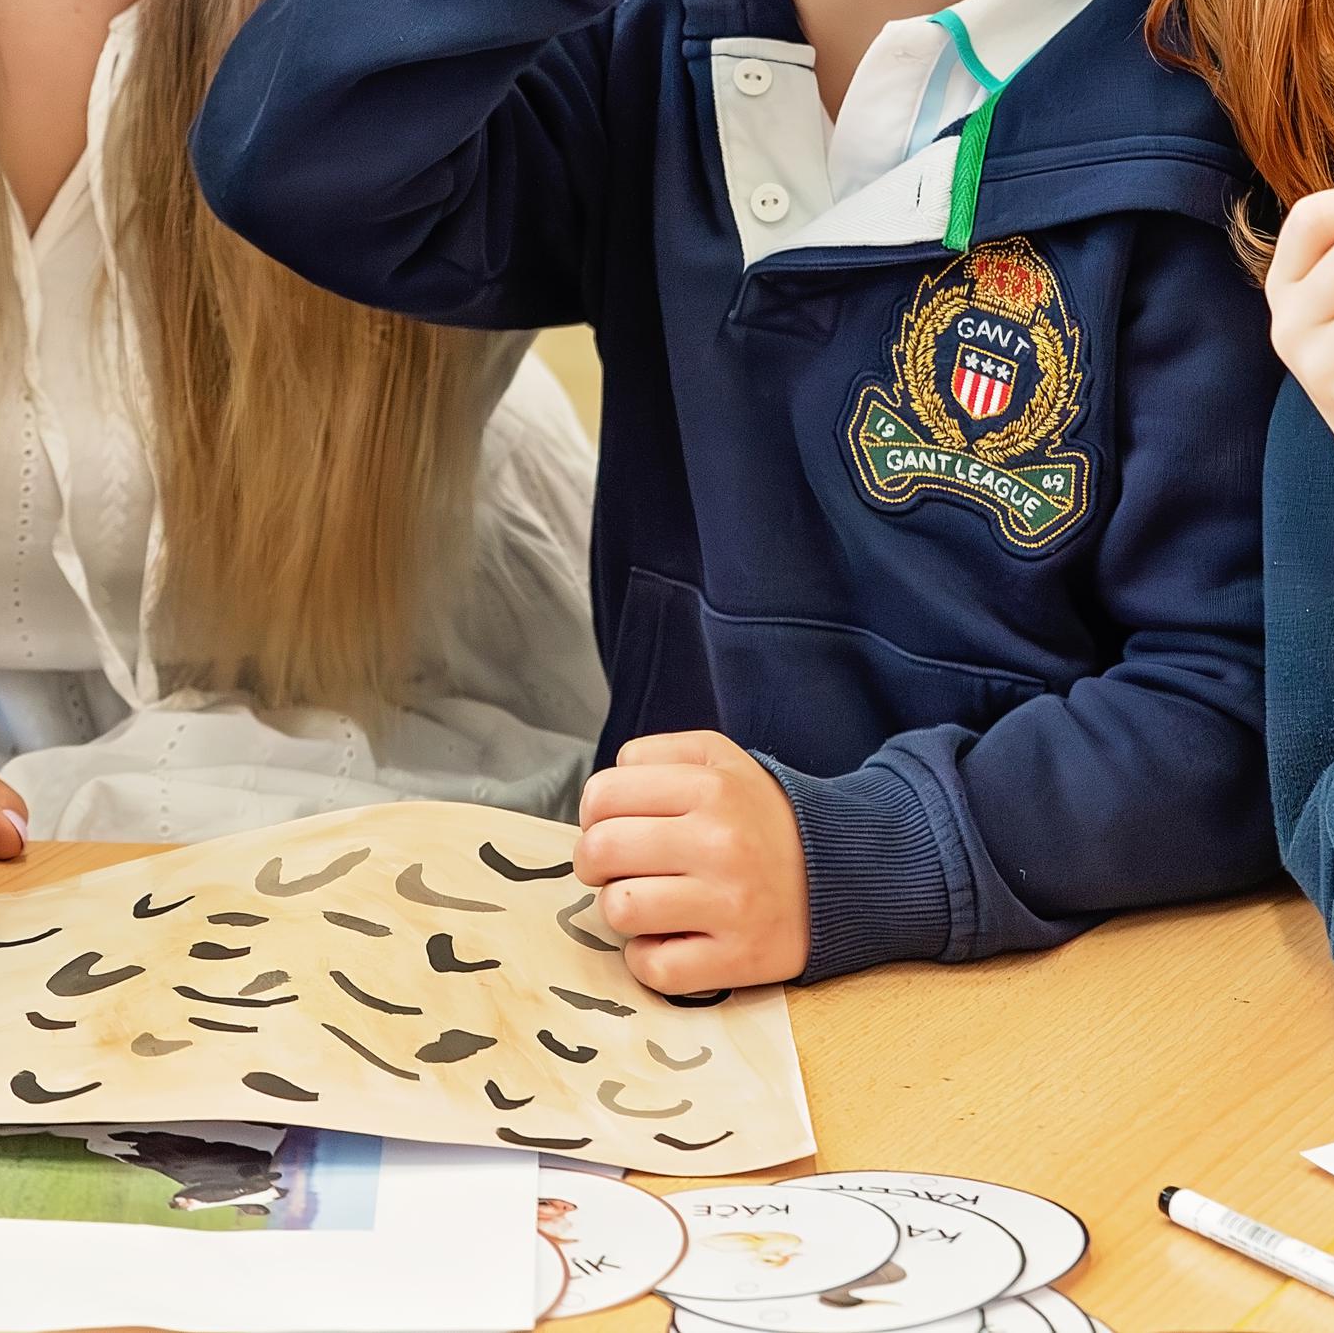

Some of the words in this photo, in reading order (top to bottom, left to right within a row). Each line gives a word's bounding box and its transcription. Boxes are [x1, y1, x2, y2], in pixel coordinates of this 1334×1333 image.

[956, 316, 1031, 357] GANT
[875, 417, 896, 438] 19
[886, 448, 952, 472] GANT
[954, 458, 1042, 518] LEAGUE
[1041, 472, 1066, 493] 49
